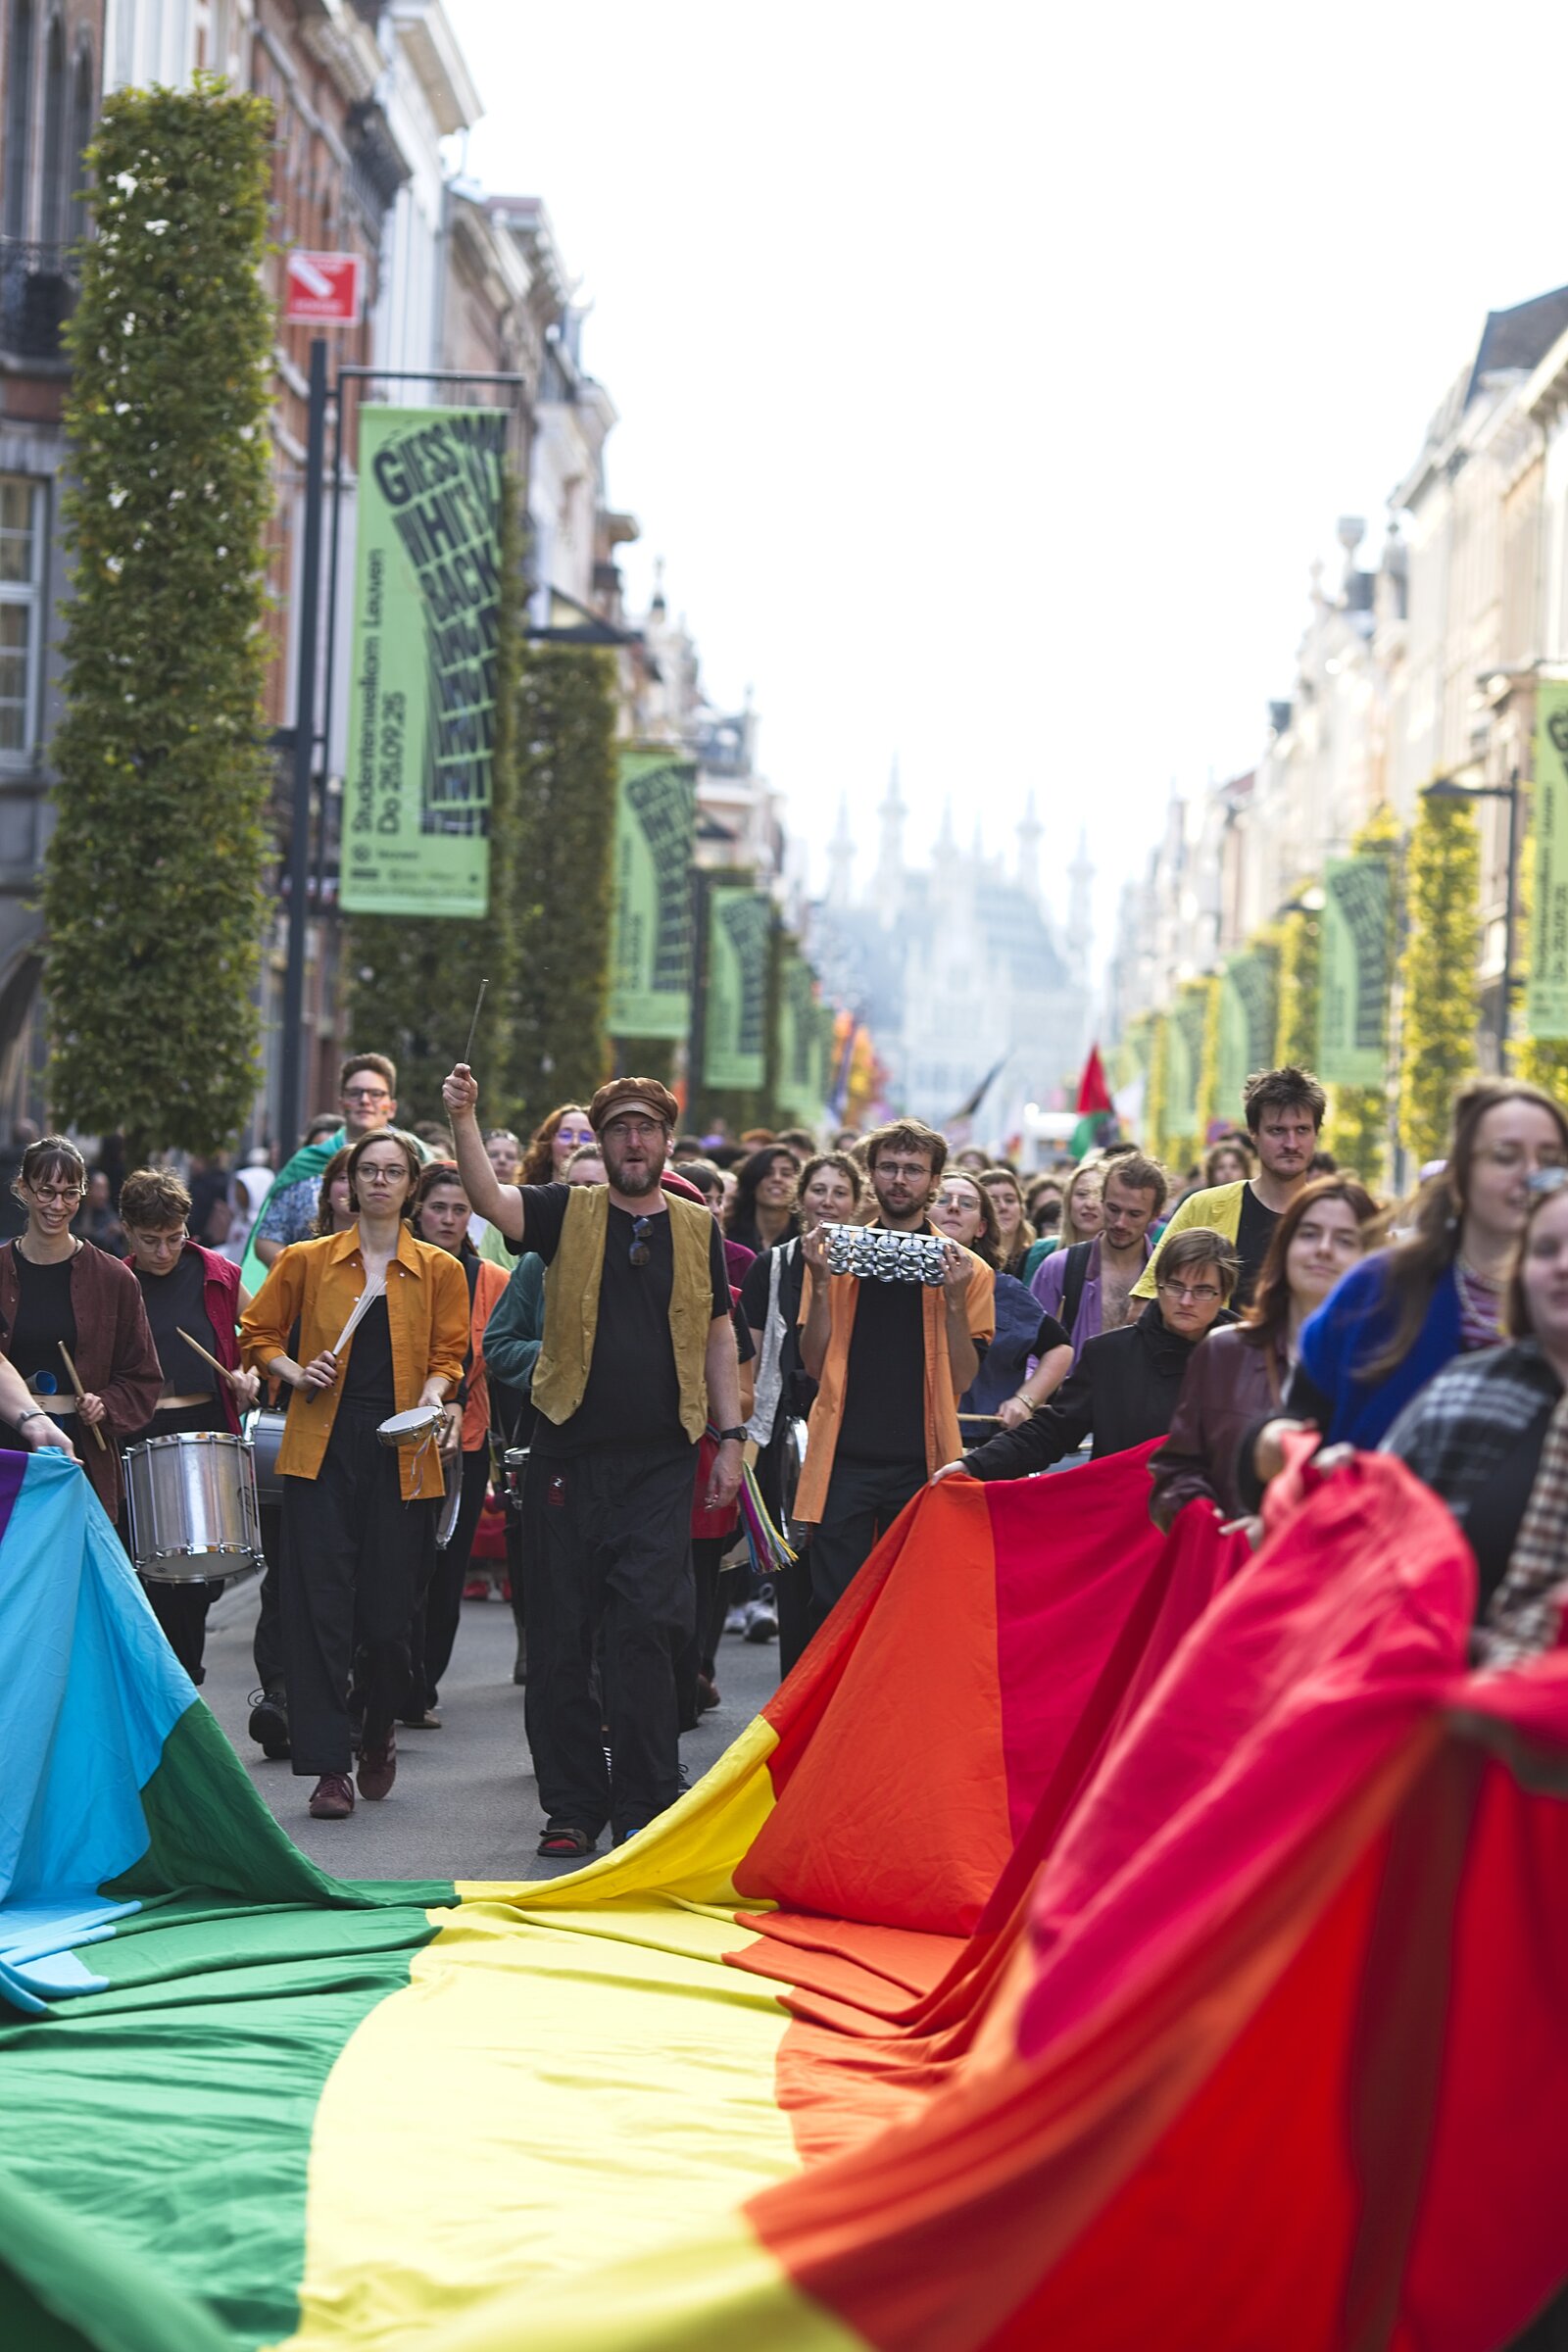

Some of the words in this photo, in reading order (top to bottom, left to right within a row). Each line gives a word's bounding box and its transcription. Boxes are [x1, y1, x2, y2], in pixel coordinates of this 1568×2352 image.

[361, 548, 385, 628] Leuven
[351, 636, 381, 834] Studentenwelkom
[379, 691, 406, 793] 25.09.25
[377, 797, 403, 835] Do
